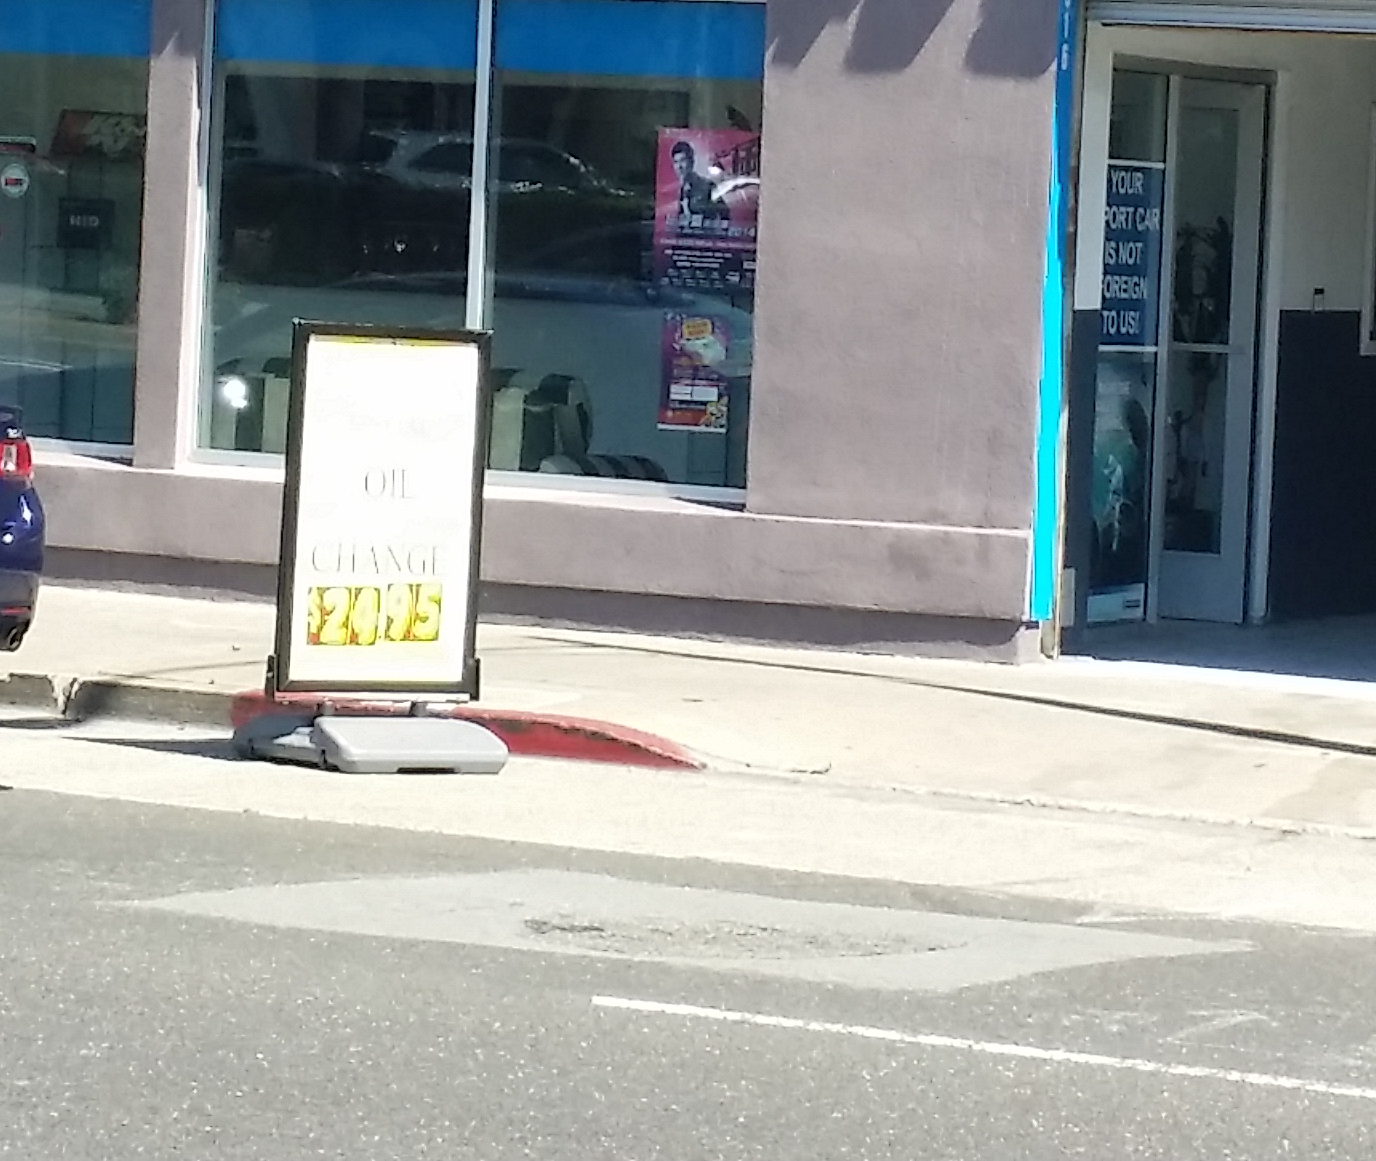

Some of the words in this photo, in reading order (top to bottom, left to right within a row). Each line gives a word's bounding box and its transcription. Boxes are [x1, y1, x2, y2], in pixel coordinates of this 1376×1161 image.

[1110, 169, 1144, 195] YOUR
[1135, 206, 1161, 231] CAR
[1104, 240, 1117, 266] IS
[1118, 241, 1144, 266] NOT
[1102, 274, 1148, 300] OREIGN
[1102, 309, 1118, 335] TO
[1120, 310, 1141, 335] US!
[364, 467, 416, 500] OIL
[311, 543, 444, 577] CHANGE
